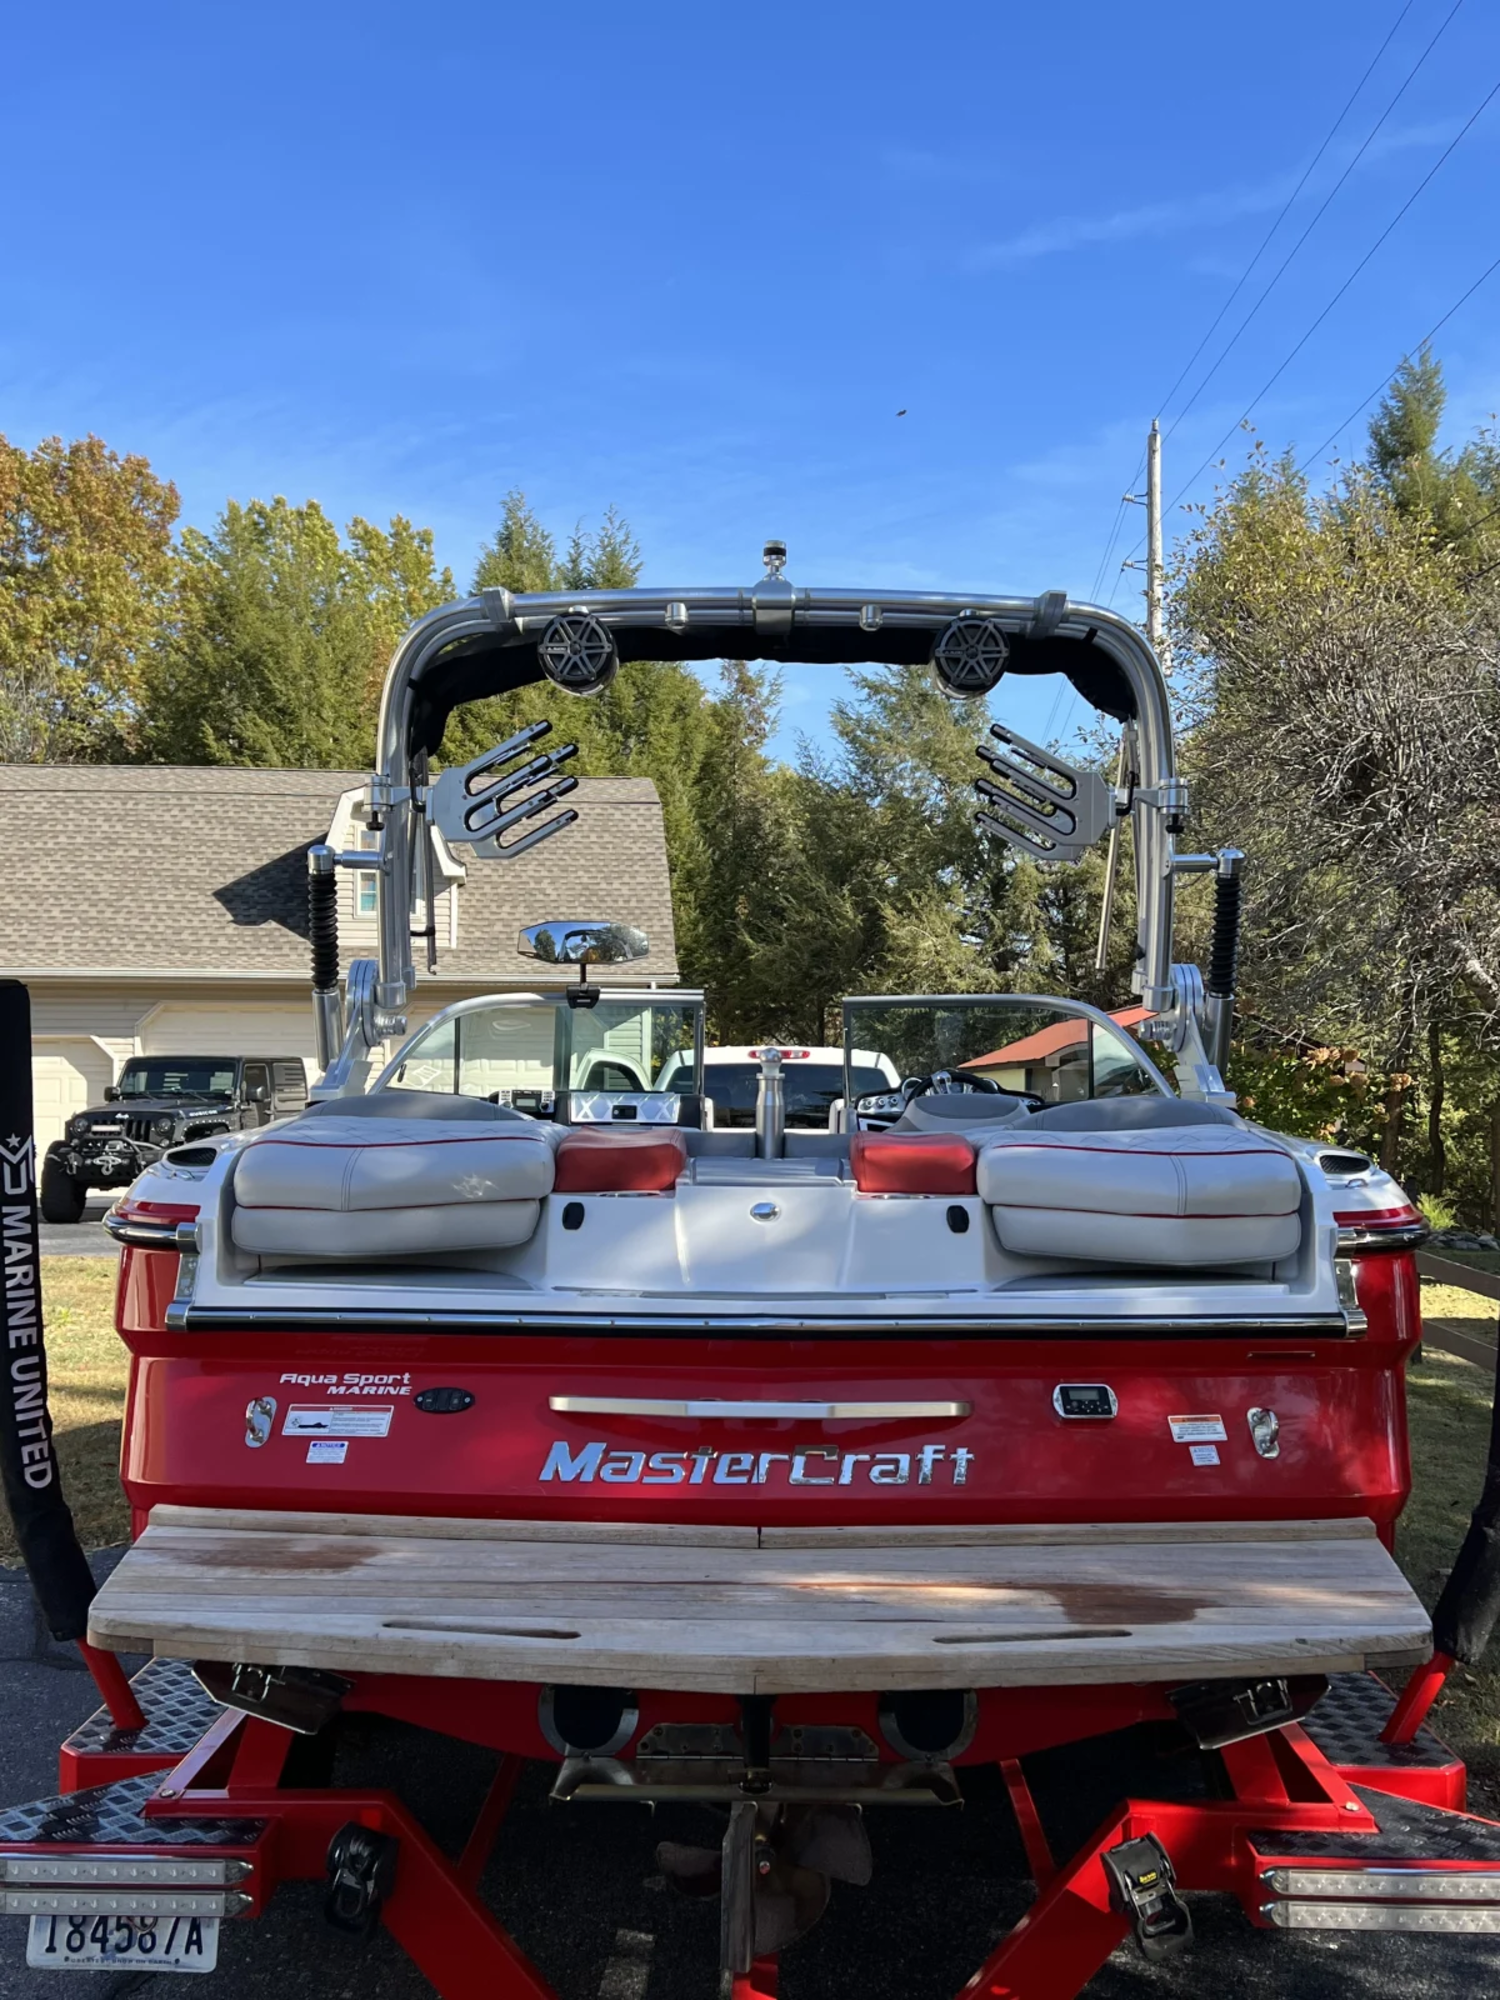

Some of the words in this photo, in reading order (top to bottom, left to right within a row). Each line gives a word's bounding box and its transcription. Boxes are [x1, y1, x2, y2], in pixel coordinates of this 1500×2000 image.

[1, 1205, 38, 1349] MARINE
[279, 1373, 336, 1387] Aqua
[343, 1372, 411, 1387] Sport
[326, 1386, 412, 1395] MARINE
[10, 1355, 53, 1489] UNITED
[538, 1441, 976, 1485] MasterCraft
